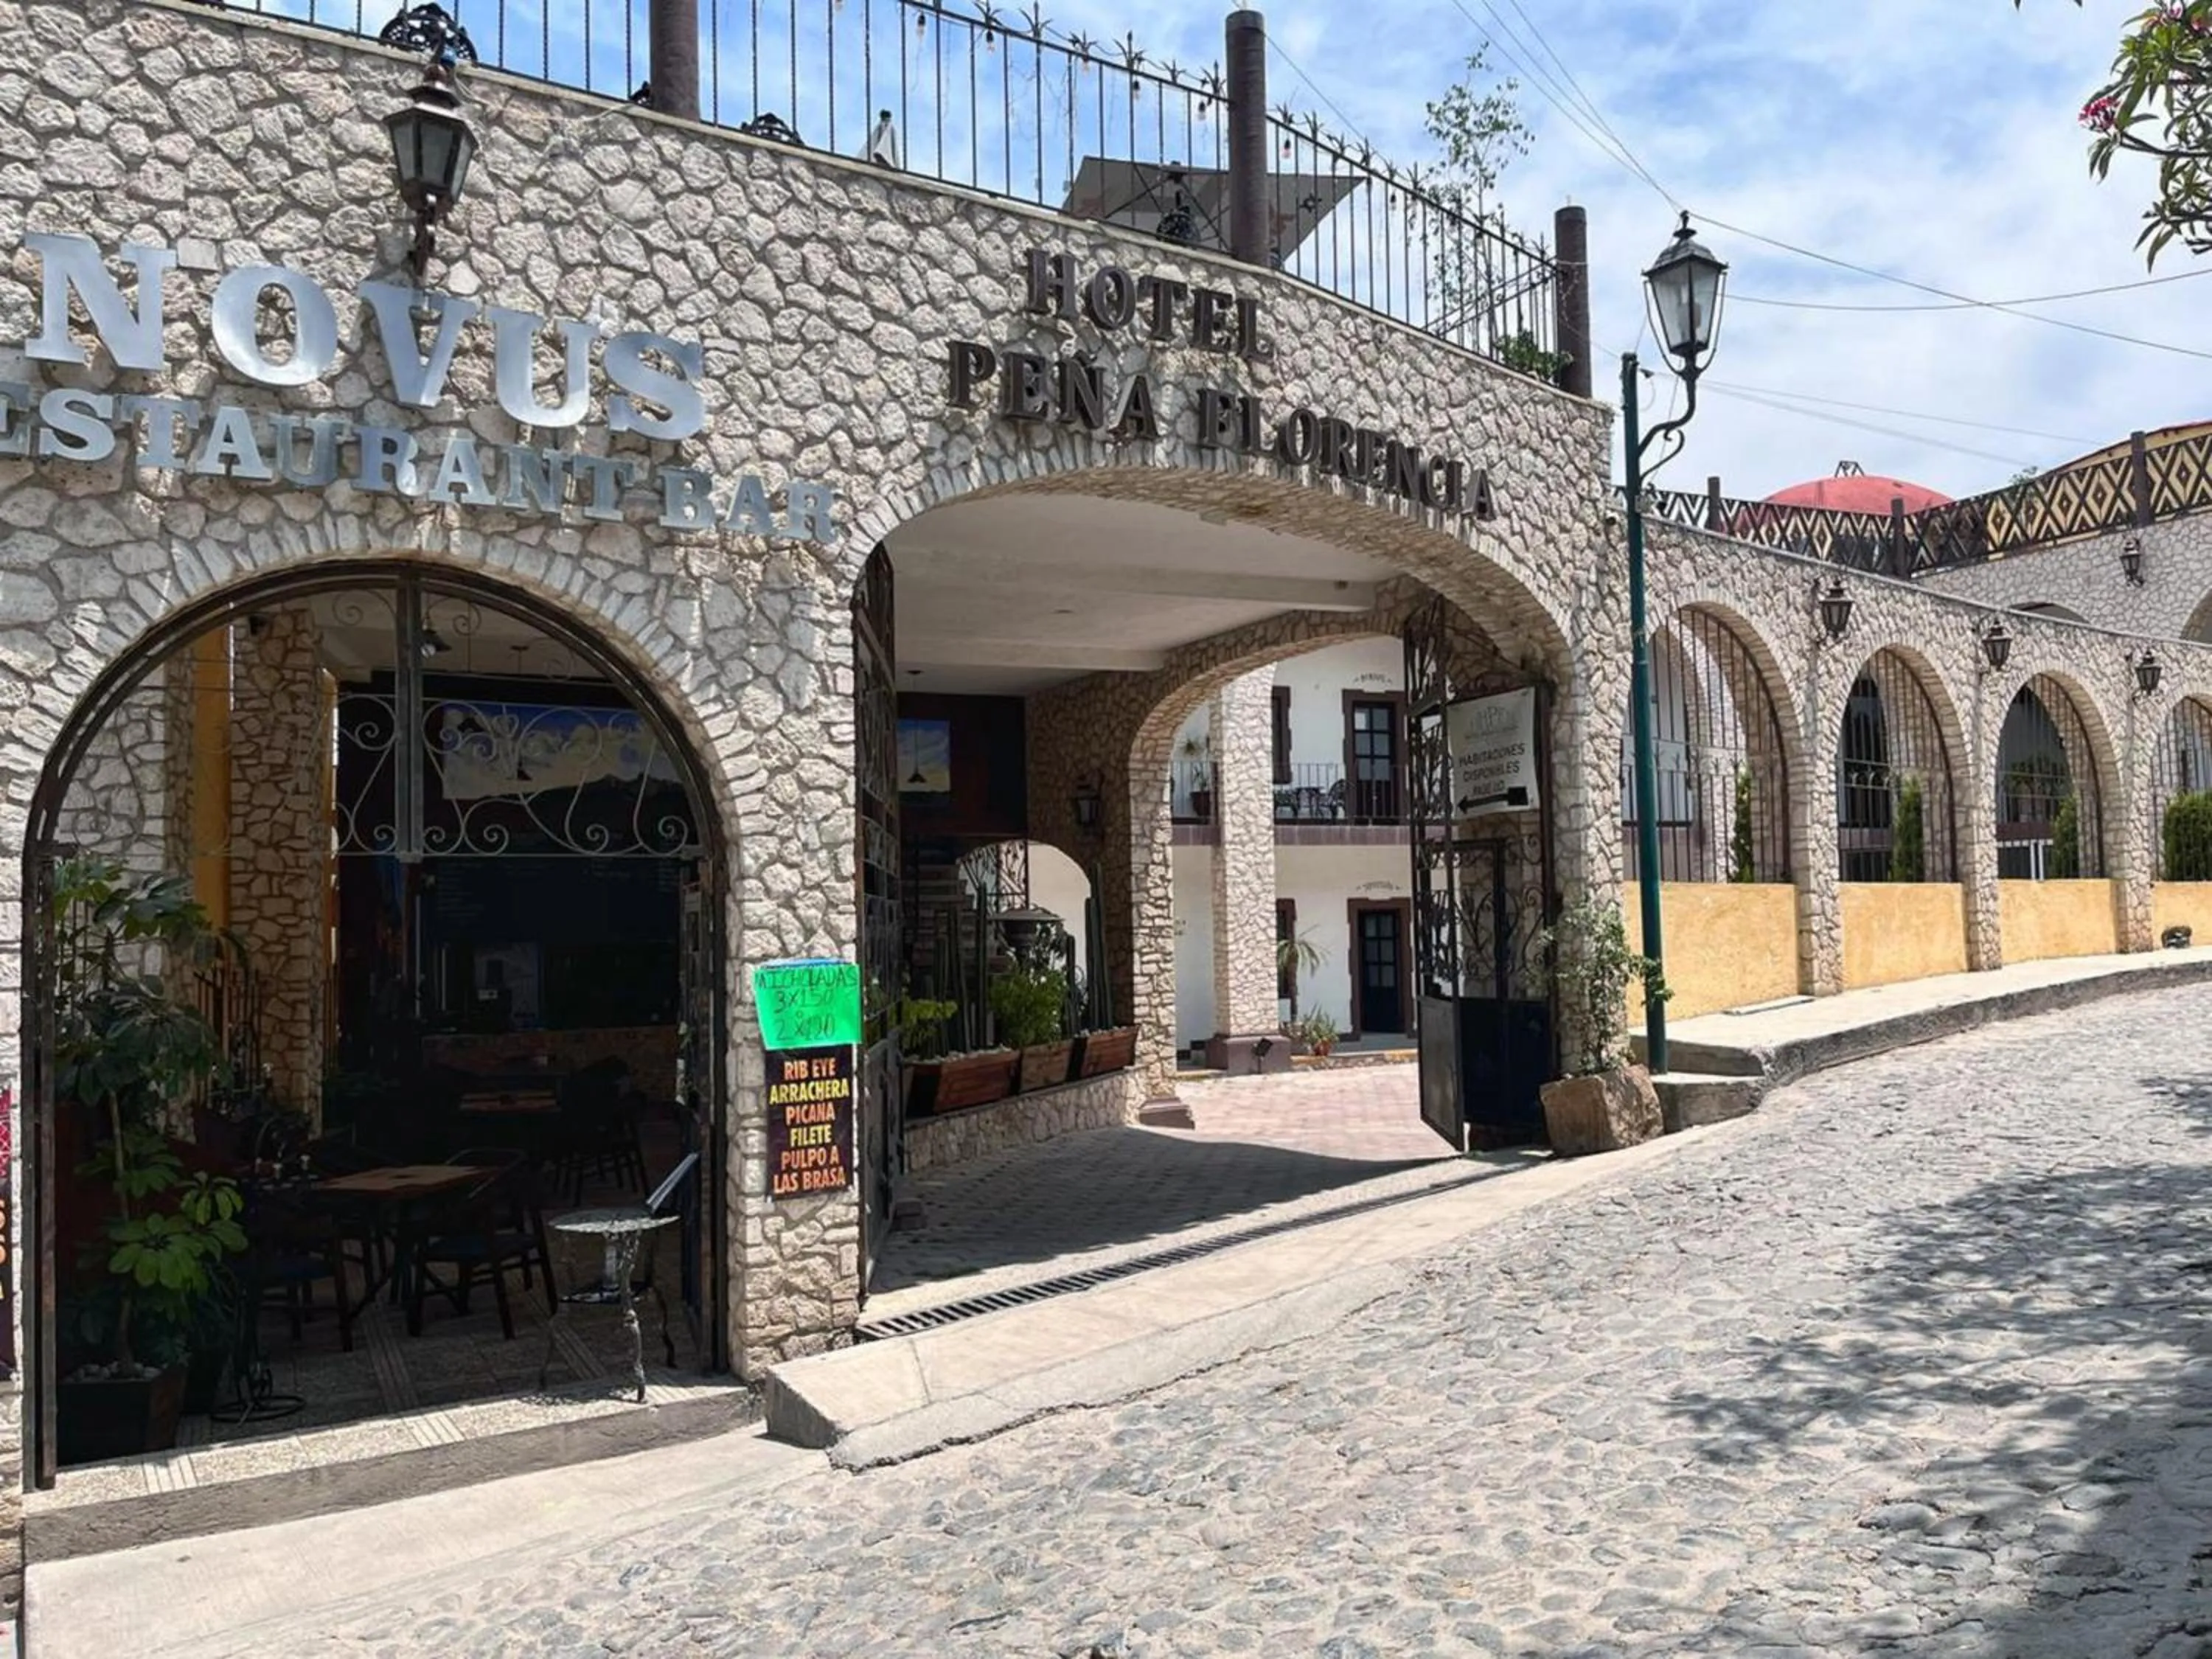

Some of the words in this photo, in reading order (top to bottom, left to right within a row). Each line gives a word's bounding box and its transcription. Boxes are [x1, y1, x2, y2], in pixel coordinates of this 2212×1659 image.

[1026, 248, 1275, 363] HOTEL
[24, 232, 706, 441] NOVUS
[946, 340, 1162, 441] PEÑA
[1196, 386, 1496, 521] FLORENCIA
[658, 467, 841, 544] BAR
[783, 1060, 809, 1080] RIB
[813, 1057, 836, 1078] EYE
[769, 1078, 849, 1105] ARRACHERA
[790, 1124, 832, 1147] FILETE
[781, 1149, 827, 1170] PULPO
[830, 1145, 839, 1164] A
[773, 1175, 799, 1194] LAS
[802, 1167, 846, 1189] BRASA
